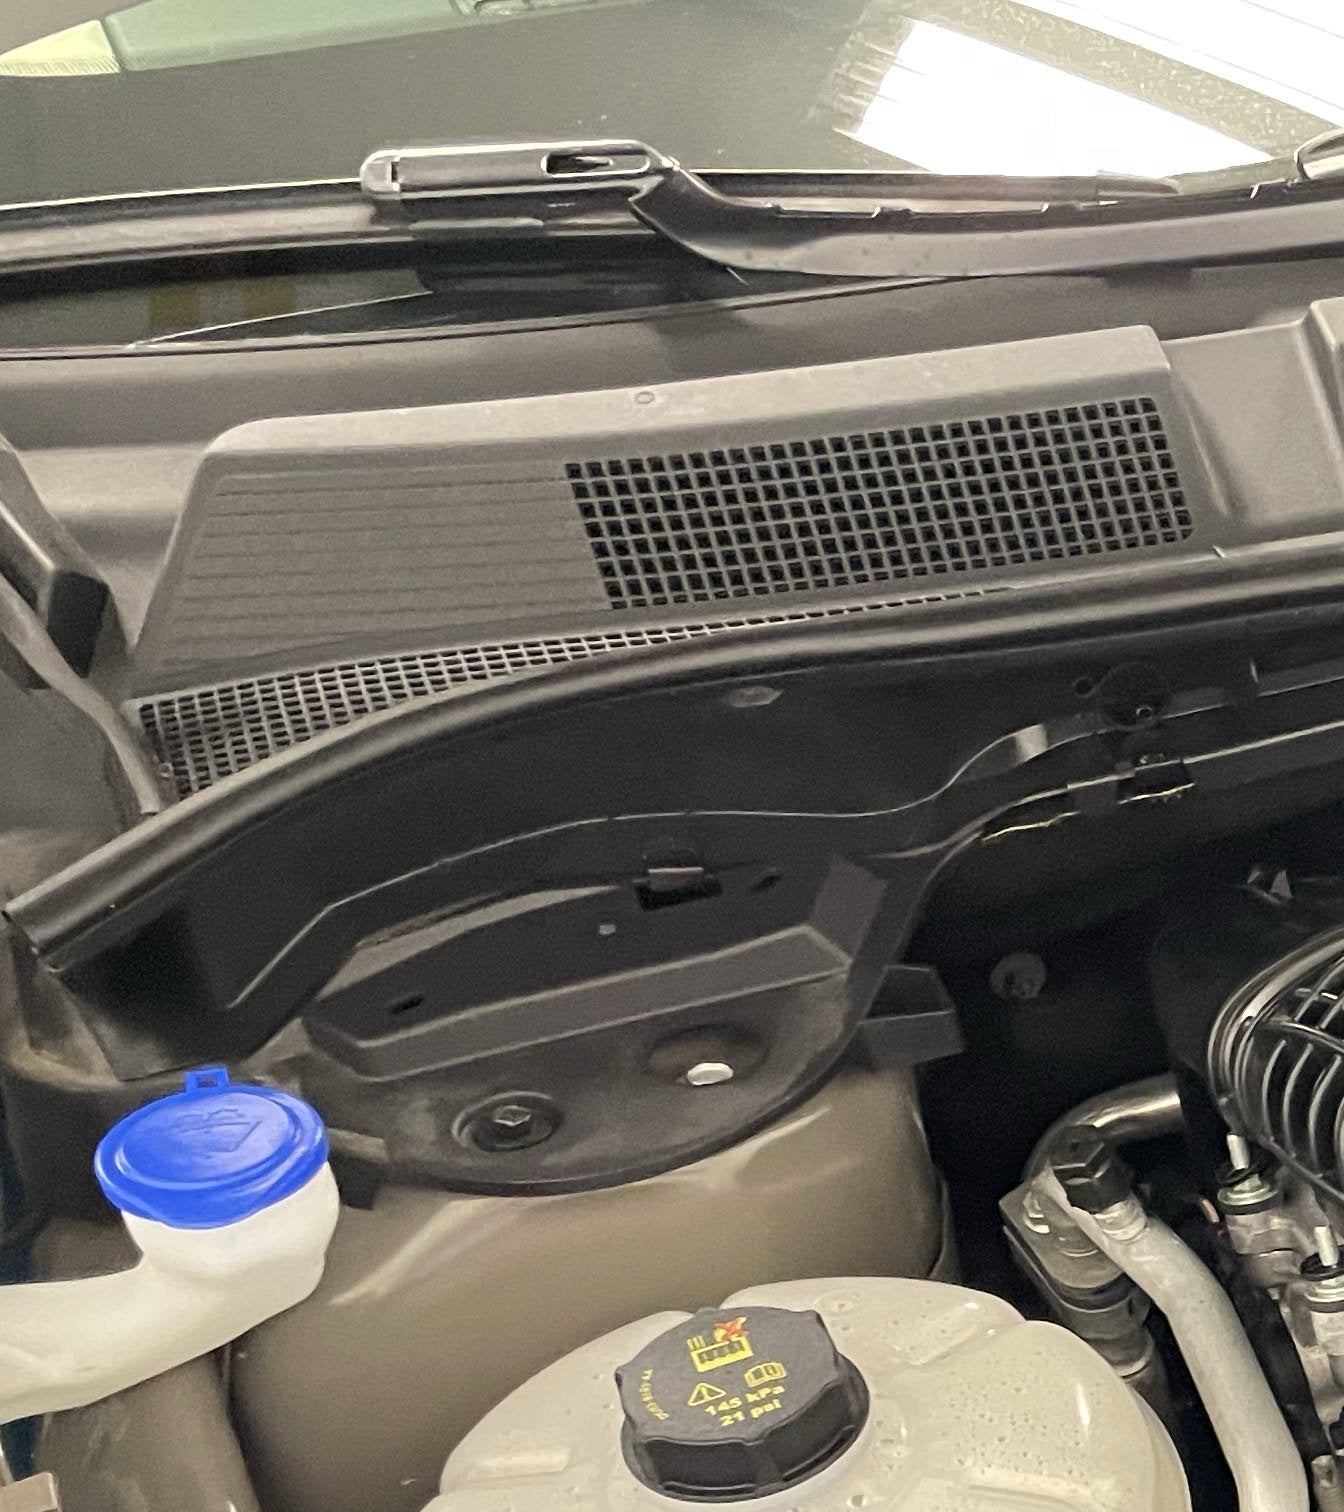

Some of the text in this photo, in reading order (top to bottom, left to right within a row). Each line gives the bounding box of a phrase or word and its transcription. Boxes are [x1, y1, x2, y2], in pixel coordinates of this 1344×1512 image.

[705, 1385, 785, 1416] 145 kPa
[719, 1399, 782, 1427] 21 psi
